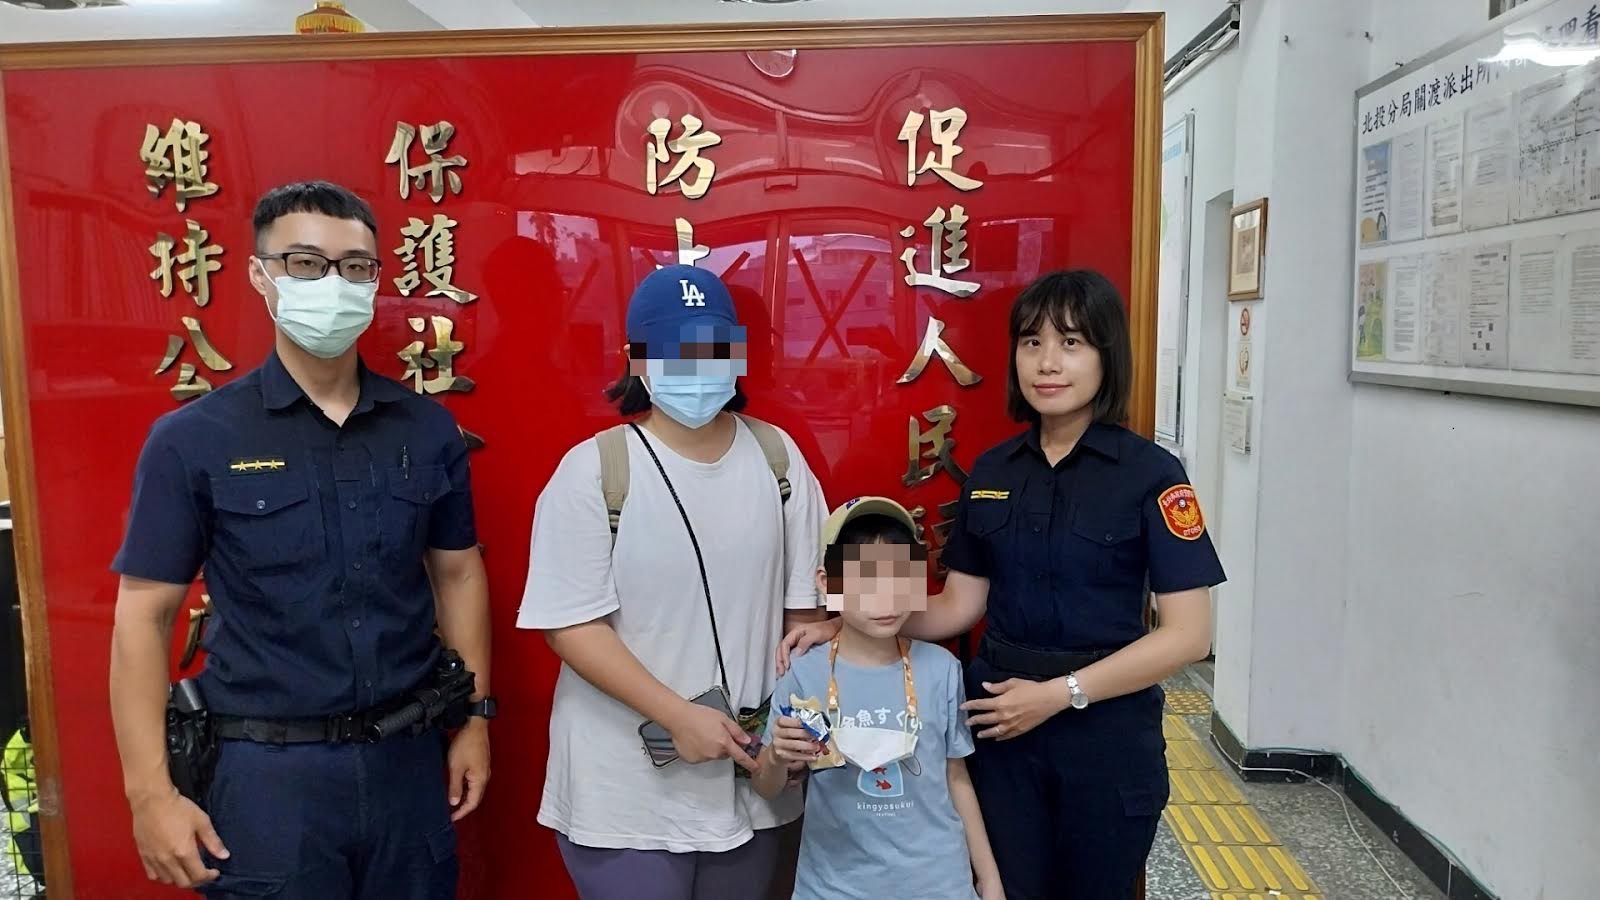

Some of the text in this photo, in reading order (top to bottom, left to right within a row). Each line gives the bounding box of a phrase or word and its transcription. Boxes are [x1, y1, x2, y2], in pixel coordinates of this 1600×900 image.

[385, 120, 485, 448] 保護社
[679, 279, 706, 307] LA
[856, 800, 914, 811] kingyosukui
